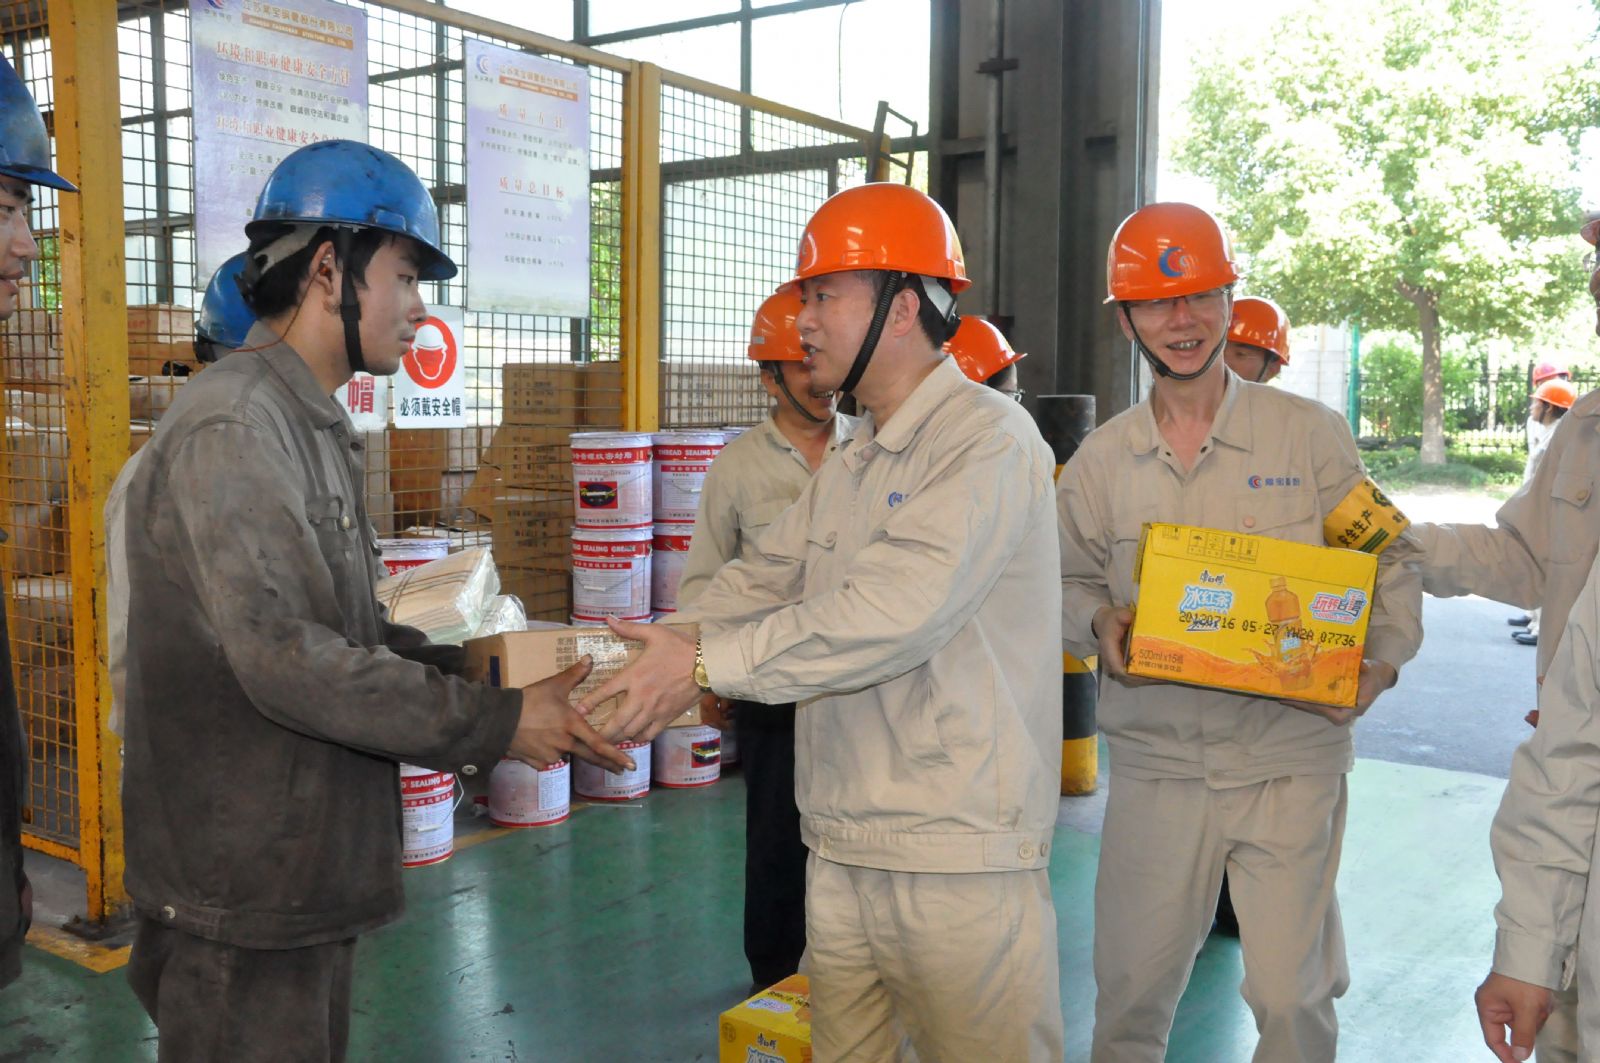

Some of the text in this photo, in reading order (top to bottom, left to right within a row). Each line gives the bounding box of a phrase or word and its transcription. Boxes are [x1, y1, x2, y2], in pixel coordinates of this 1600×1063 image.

[347, 376, 375, 414] 帽
[400, 396, 461, 417] 必须戴安全帽
[1337, 509, 1373, 548] 安全生产
[583, 544, 608, 552] SEALING
[611, 545, 636, 553] GREASE
[1199, 570, 1226, 586] 康师傅
[1180, 586, 1233, 611] 冰红茶
[1320, 632, 1356, 648] 07736
[411, 776, 440, 788] SEALING
